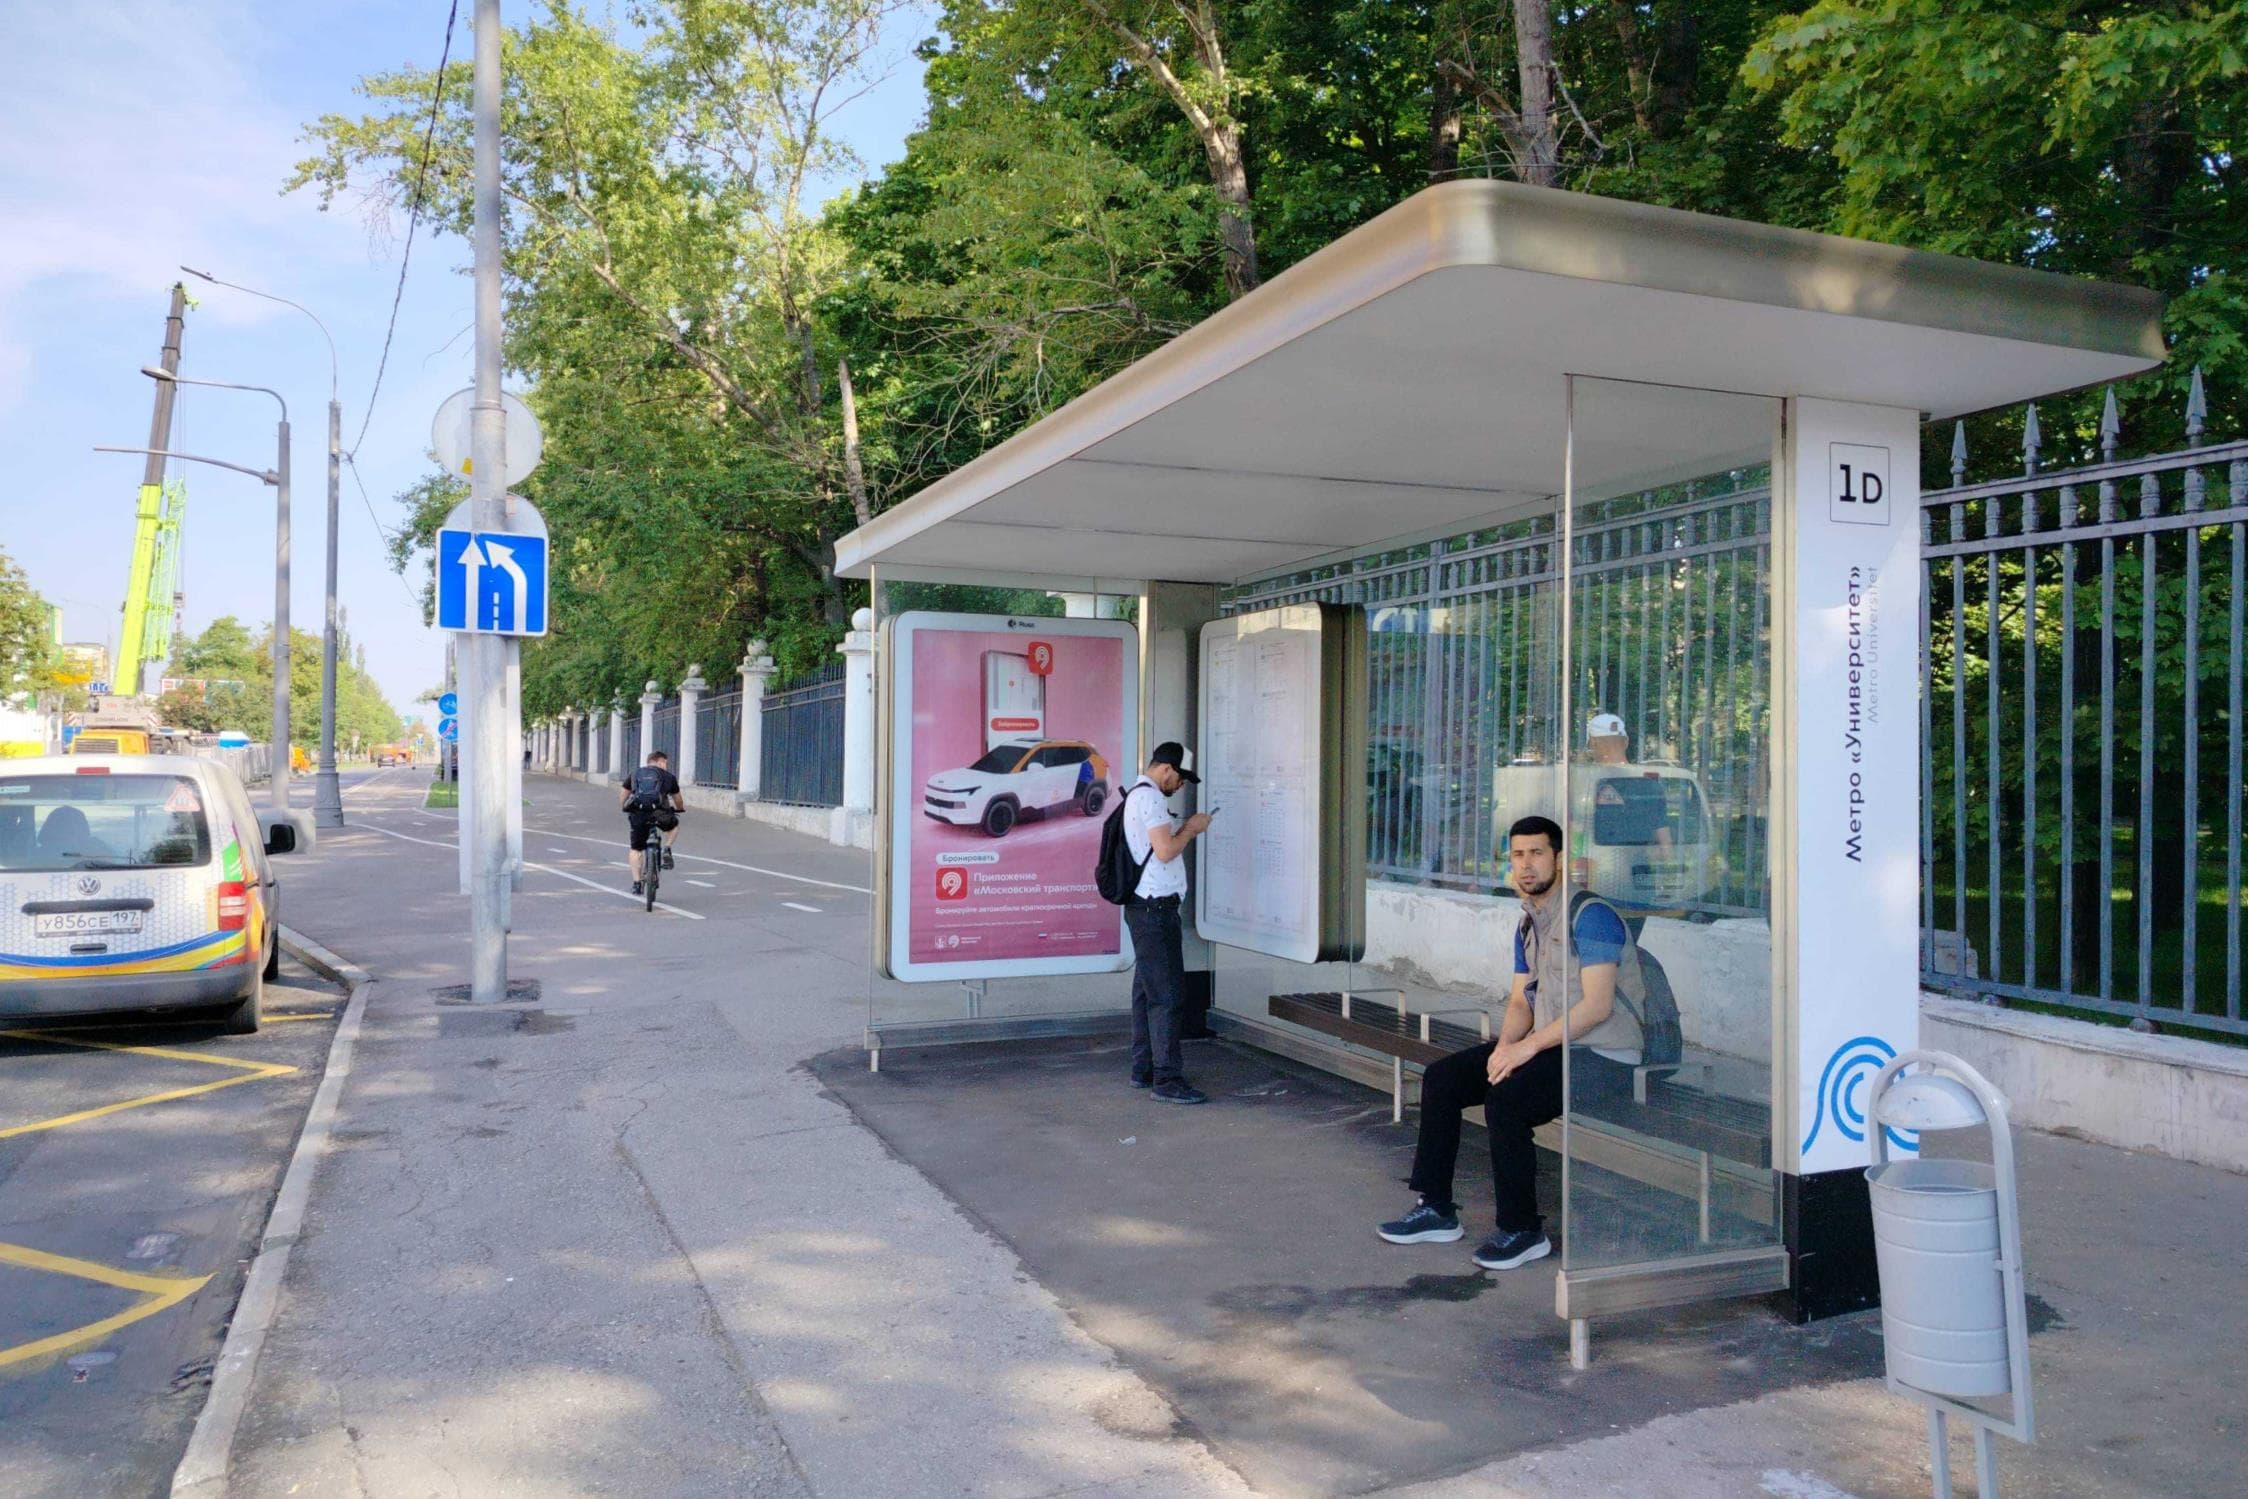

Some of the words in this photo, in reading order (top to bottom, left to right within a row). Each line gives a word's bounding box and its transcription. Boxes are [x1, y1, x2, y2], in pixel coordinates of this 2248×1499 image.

[1838, 463, 1883, 504] 1D
[1867, 566, 1878, 663] Universitet
[1845, 564, 1863, 764] «Университет»
[1867, 668, 1878, 724] Metro
[1846, 771, 1865, 863] Метро
[942, 854, 995, 864] Бронировать
[973, 872, 1038, 882] Приложение
[973, 884, 1041, 896] «Московский
[112, 911, 137, 923] 197
